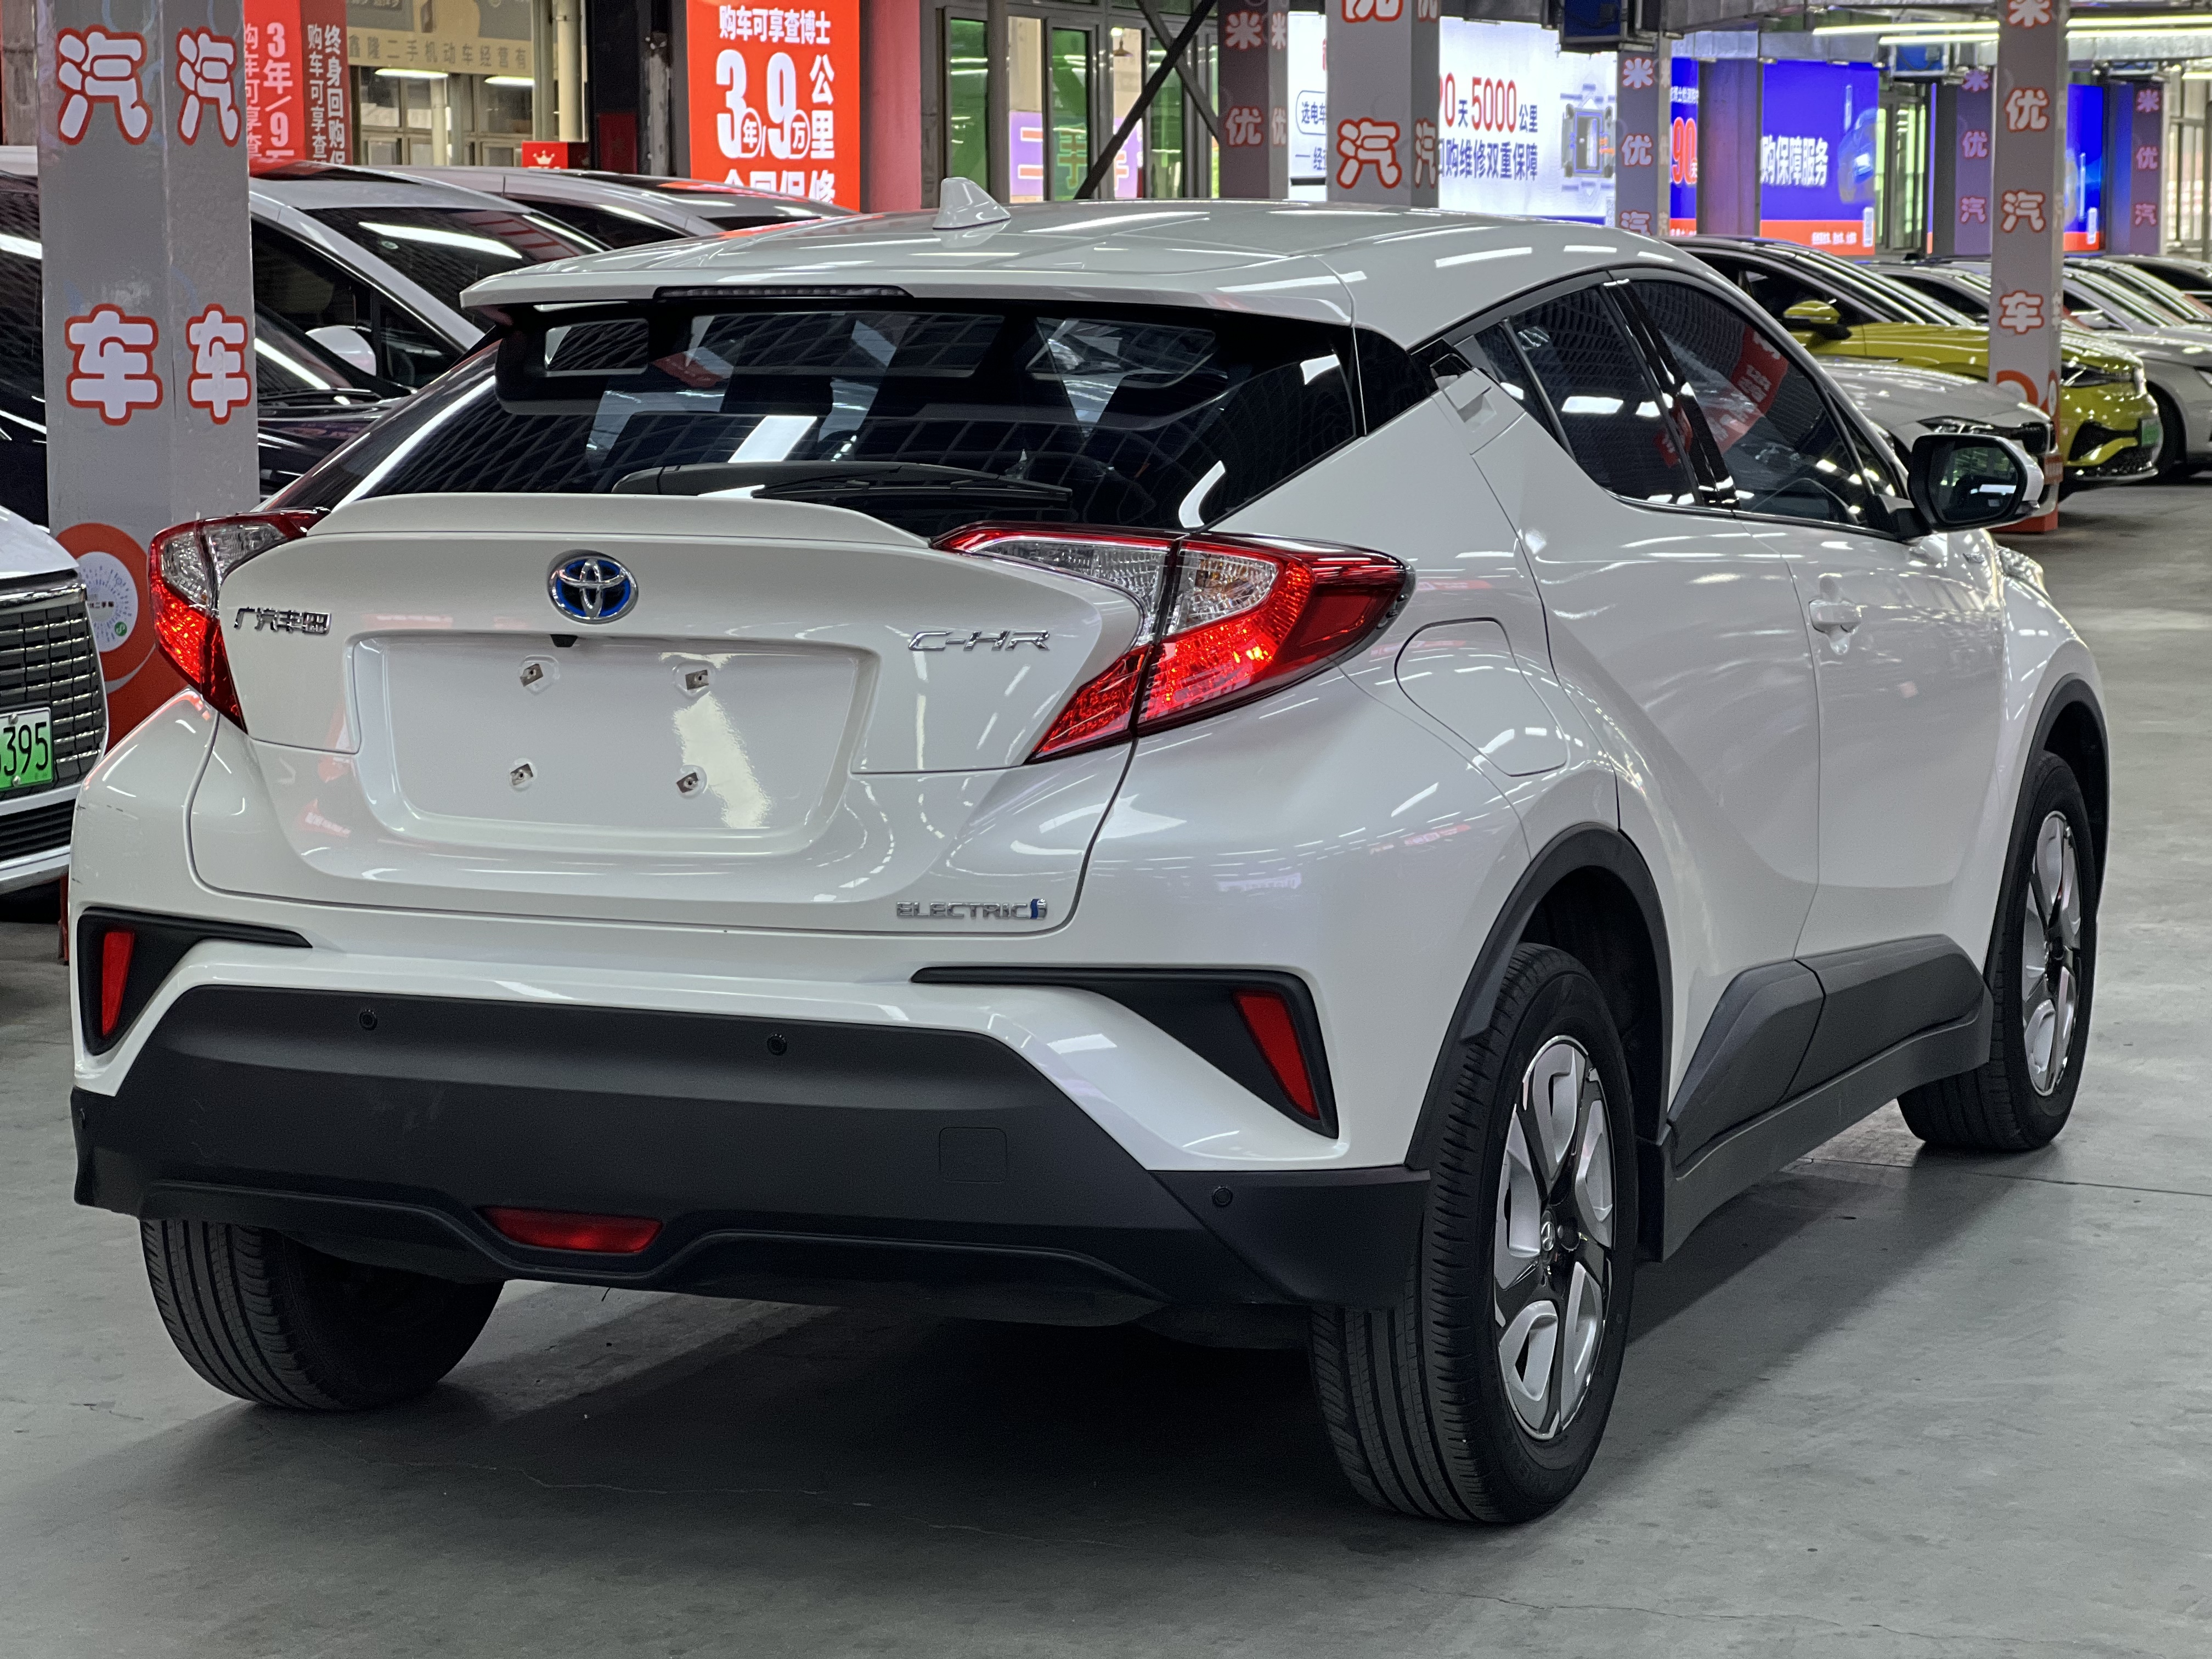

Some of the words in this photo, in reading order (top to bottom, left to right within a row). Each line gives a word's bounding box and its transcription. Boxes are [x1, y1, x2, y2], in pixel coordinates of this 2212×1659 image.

[719, 5, 831, 44] 购车可享查博士
[263, 22, 294, 159] 3年/9
[307, 23, 327, 163] 购车可享查
[233, 606, 332, 636] 广汽丰田
[908, 629, 1051, 652] C-HR
[896, 901, 1030, 920] ELECTRIC
